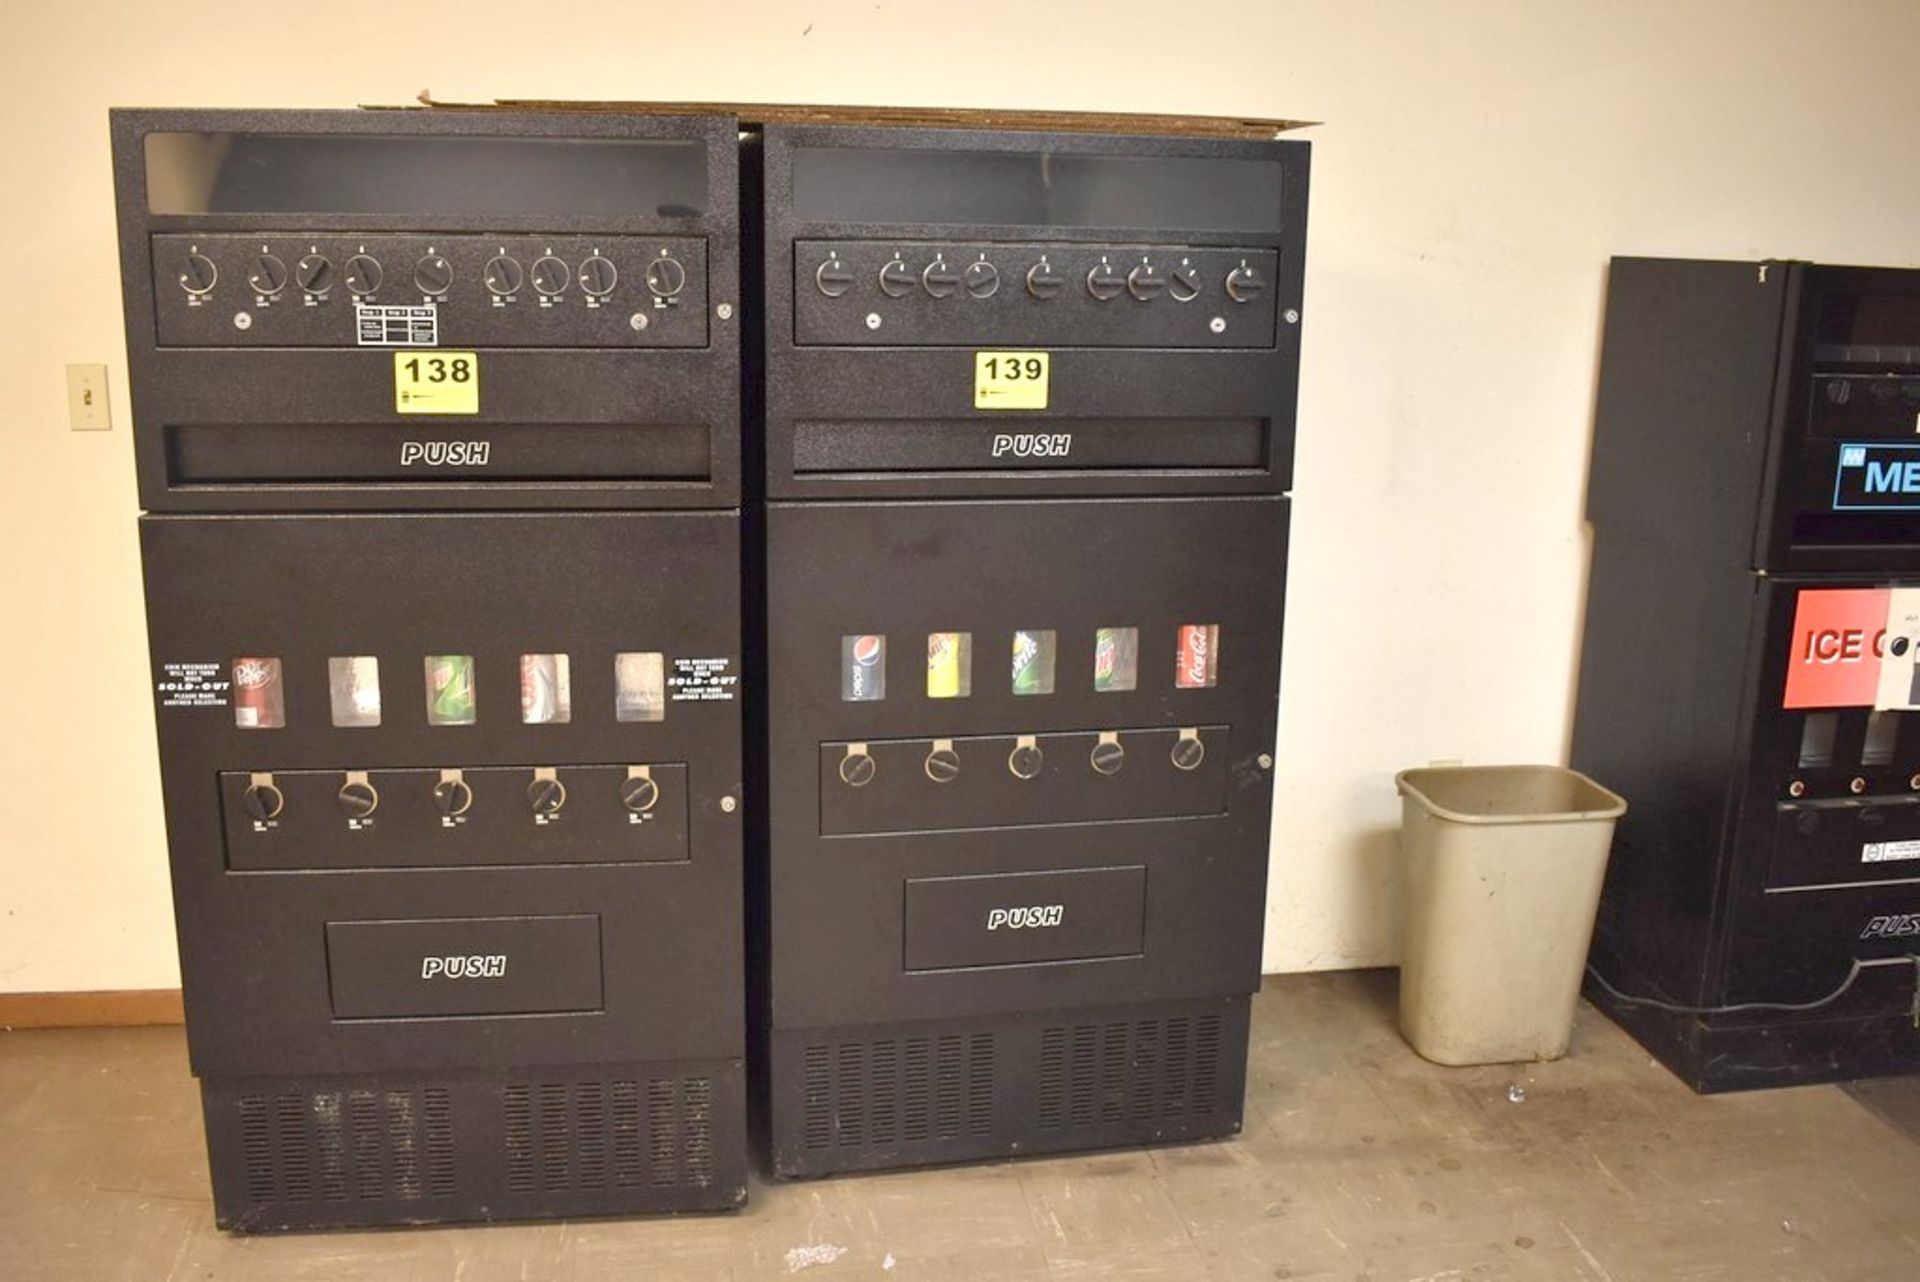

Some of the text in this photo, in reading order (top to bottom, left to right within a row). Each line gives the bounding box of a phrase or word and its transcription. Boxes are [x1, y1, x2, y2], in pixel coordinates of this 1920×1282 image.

[405, 358, 471, 383] 138
[985, 357, 1042, 380] 139
[401, 442, 490, 465] PUSH
[992, 434, 1071, 457] PUSH
[1804, 629, 1864, 663] ICE
[158, 682, 230, 690] SOLD-OUT
[667, 676, 737, 686] SOLD-OUT
[987, 905, 1064, 930] PUSH
[422, 956, 507, 979] PUSH
